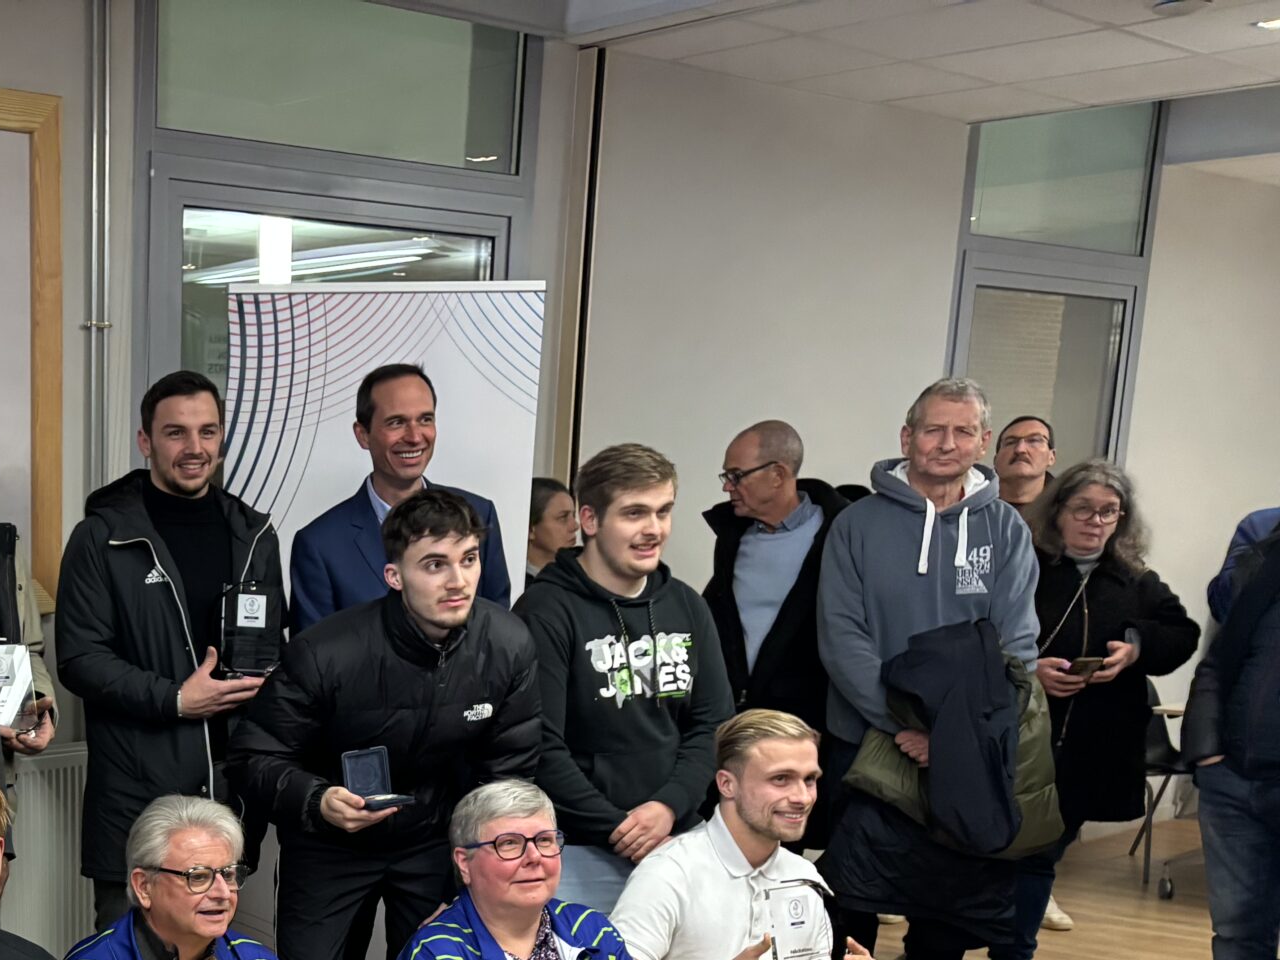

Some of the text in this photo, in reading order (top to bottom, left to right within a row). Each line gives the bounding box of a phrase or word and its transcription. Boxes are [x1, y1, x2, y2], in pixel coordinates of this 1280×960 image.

[145, 576, 170, 584] adida
[596, 639, 674, 670] JACK
[599, 664, 692, 698] JONES
